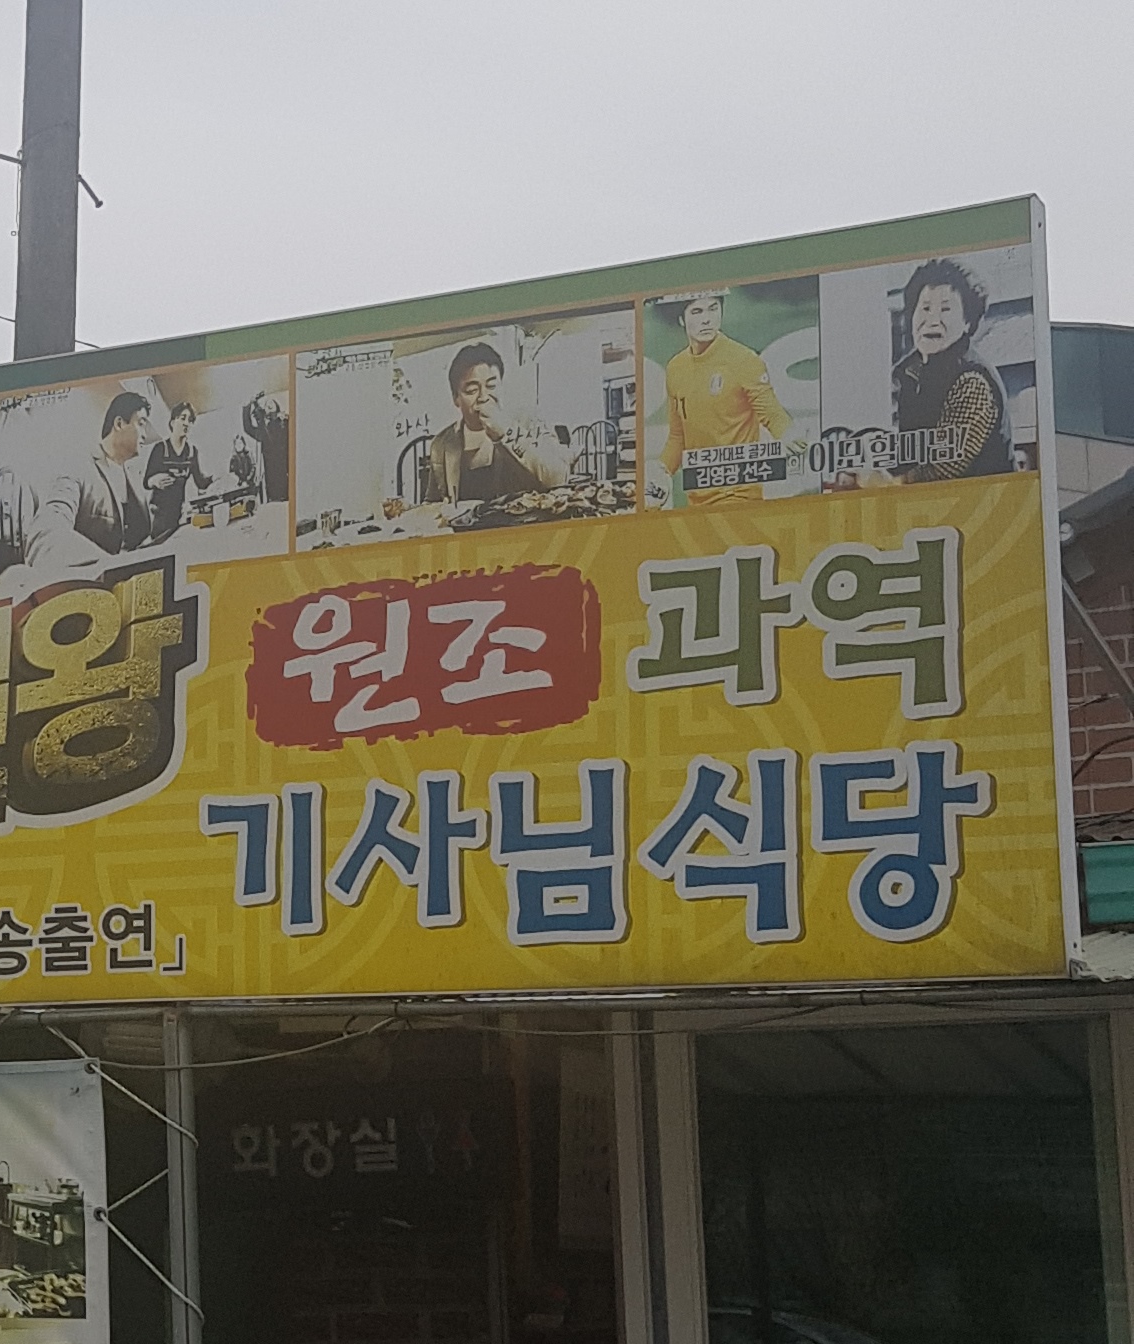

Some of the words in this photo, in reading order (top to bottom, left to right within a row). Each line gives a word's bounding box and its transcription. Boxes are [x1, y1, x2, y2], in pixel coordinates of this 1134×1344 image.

[686, 451, 699, 466] 전
[699, 445, 745, 465] 국가대표
[748, 442, 782, 460] 골키퍼
[695, 465, 741, 486] 김영광
[742, 462, 773, 483] 선수
[786, 455, 805, 476] 의
[808, 436, 866, 473] 이모
[282, 594, 555, 734] 원조
[632, 534, 956, 714] 과역
[232, 1116, 399, 1179] 화장실
